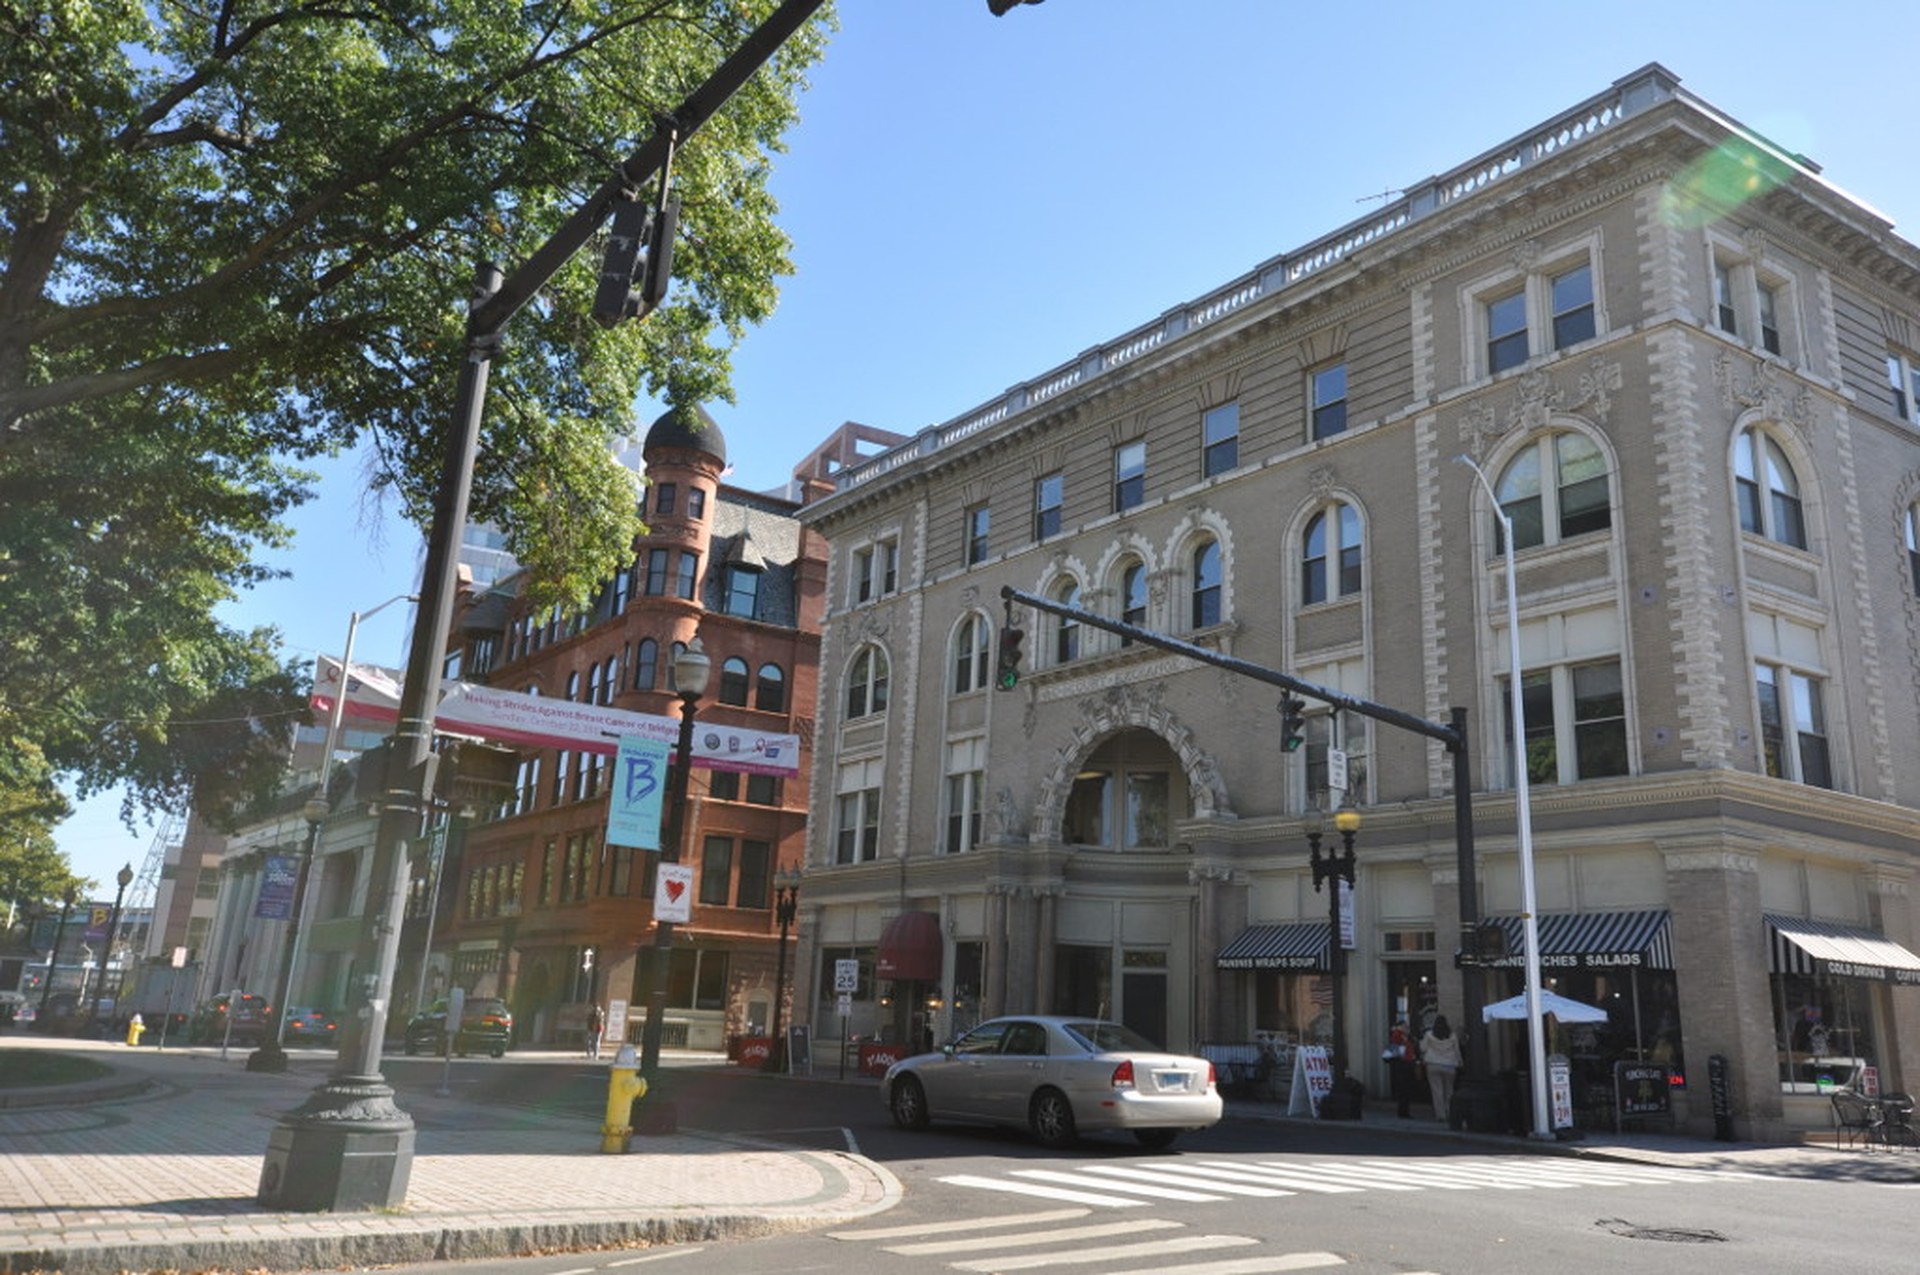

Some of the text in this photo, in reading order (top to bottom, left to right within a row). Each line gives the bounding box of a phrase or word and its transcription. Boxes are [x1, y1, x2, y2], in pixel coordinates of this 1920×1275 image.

[502, 699, 538, 713] Strides
[539, 705, 573, 718] Against
[575, 711, 605, 725] Breast
[605, 716, 636, 728] Cancer
[637, 721, 647, 730] of
[648, 723, 680, 736] Bridgep
[1255, 957, 1288, 968] WRAPS
[1289, 956, 1316, 968] SOUP
[1492, 953, 1641, 968] ANDCHES SALADS
[1827, 961, 1853, 976] COLD
[837, 975, 856, 989] 25
[1306, 1056, 1329, 1072] ATM
